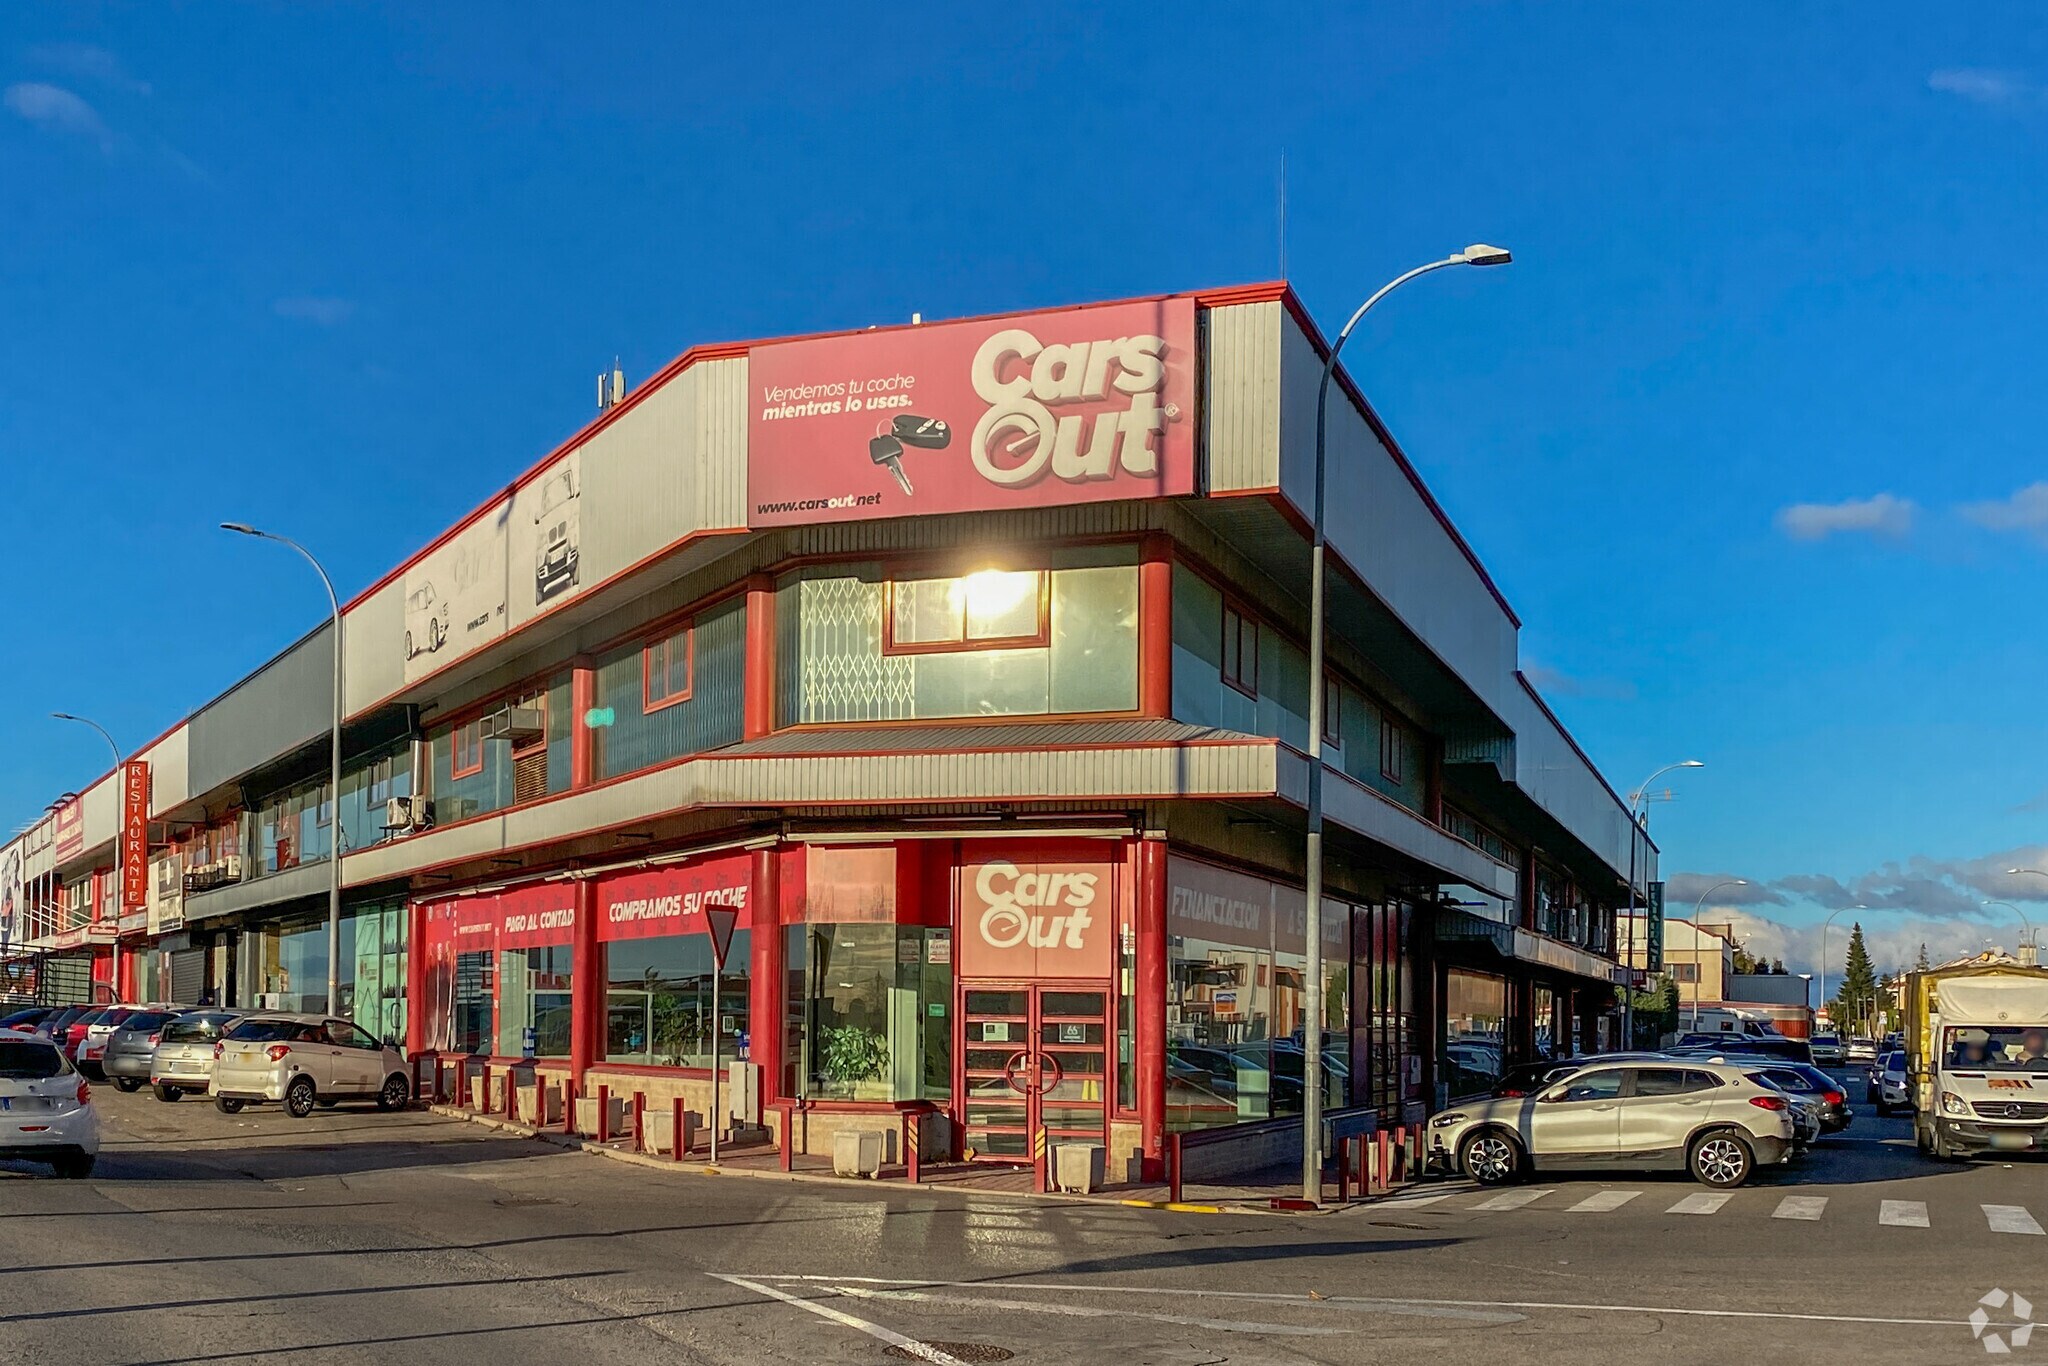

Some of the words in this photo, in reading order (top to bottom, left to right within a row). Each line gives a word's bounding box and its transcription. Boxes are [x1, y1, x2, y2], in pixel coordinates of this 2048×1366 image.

[971, 329, 1167, 405] Cars
[762, 401, 842, 420] mientras
[845, 396, 863, 412] lo
[866, 393, 913, 410] usas.
[764, 382, 845, 403] Vendemos
[848, 379, 864, 394] tu
[866, 373, 915, 392] coche
[970, 392, 1167, 485] Out
[757, 492, 881, 514] www.carsout.net
[128, 765, 142, 902] RESTAURANTE
[976, 860, 1099, 907] Cars
[504, 914, 526, 933] PAGO
[526, 913, 538, 931] AL
[540, 908, 575, 929] CONTAD
[609, 894, 682, 922] COMPRAMOS
[683, 891, 701, 915] SU
[979, 904, 1093, 949] Out
